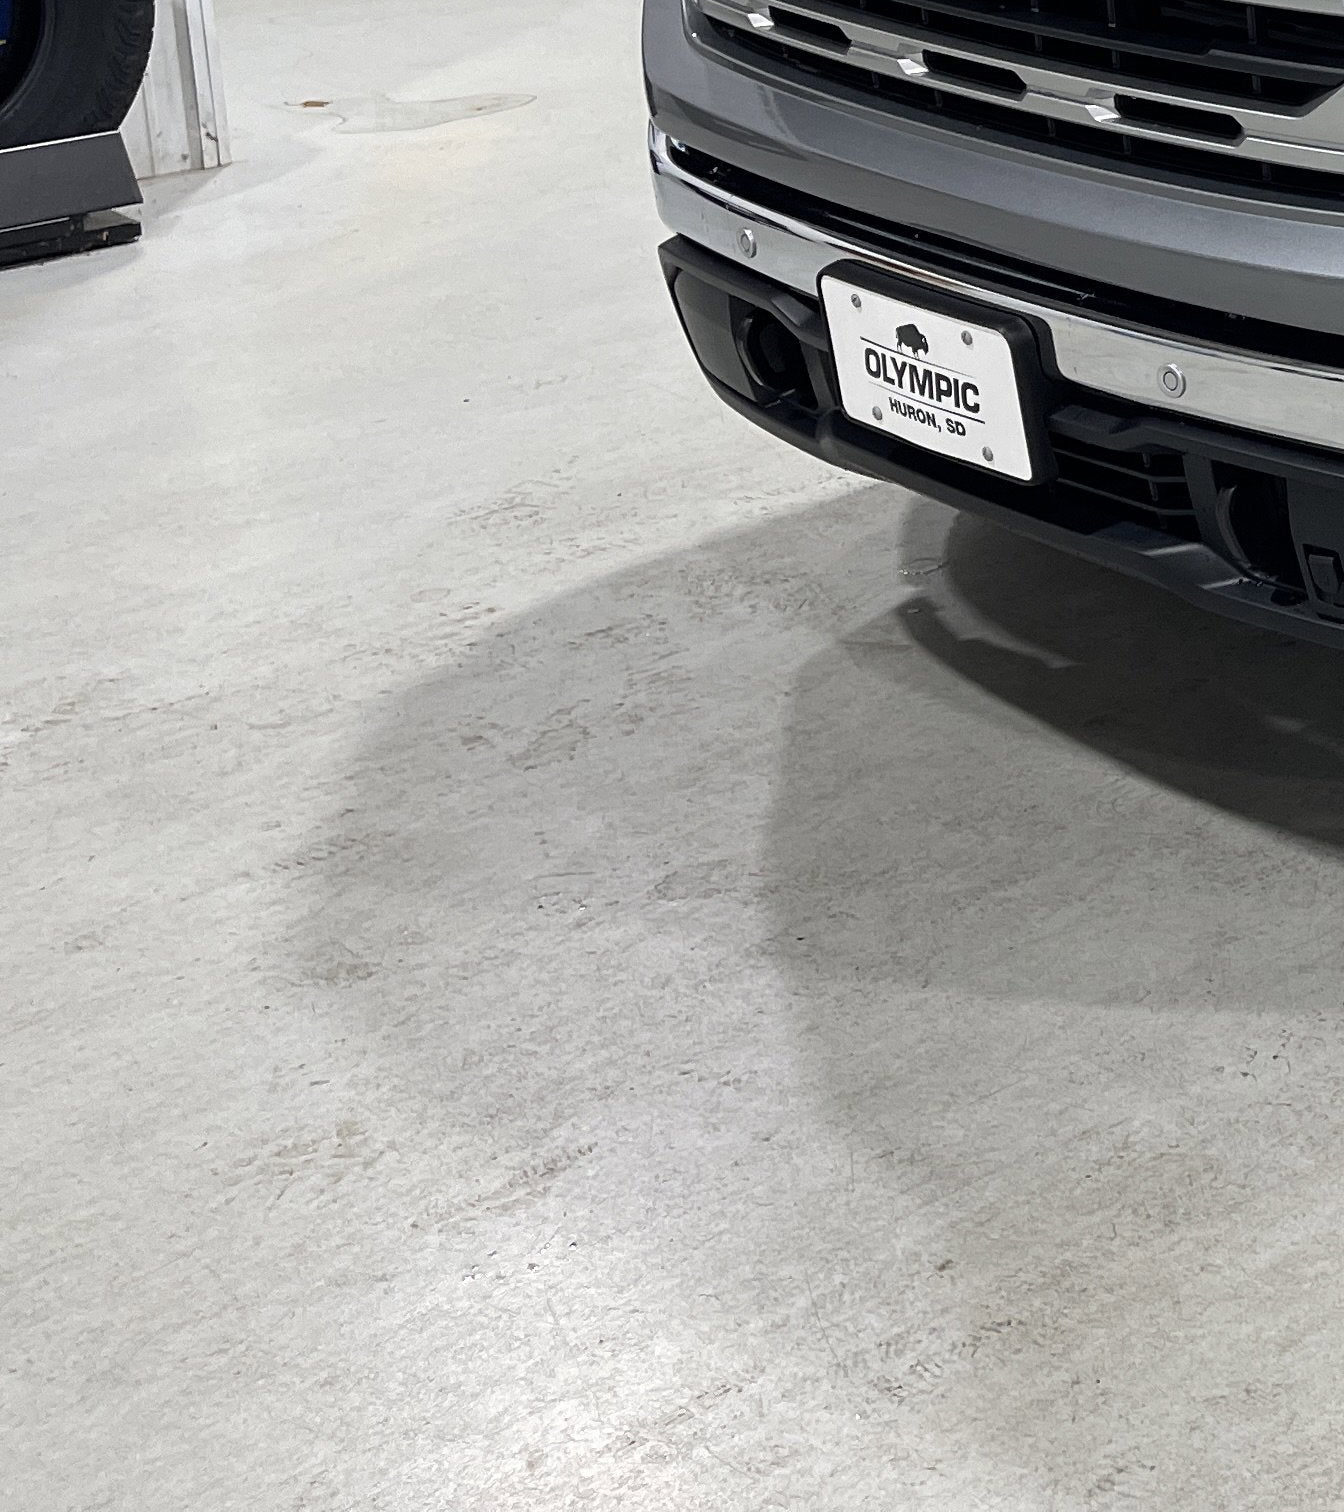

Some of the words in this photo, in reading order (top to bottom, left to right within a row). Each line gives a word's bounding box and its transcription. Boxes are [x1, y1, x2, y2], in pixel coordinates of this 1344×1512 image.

[864, 347, 981, 414] OLYMPIC
[888, 397, 942, 433] HURON,
[946, 417, 967, 437] SD
